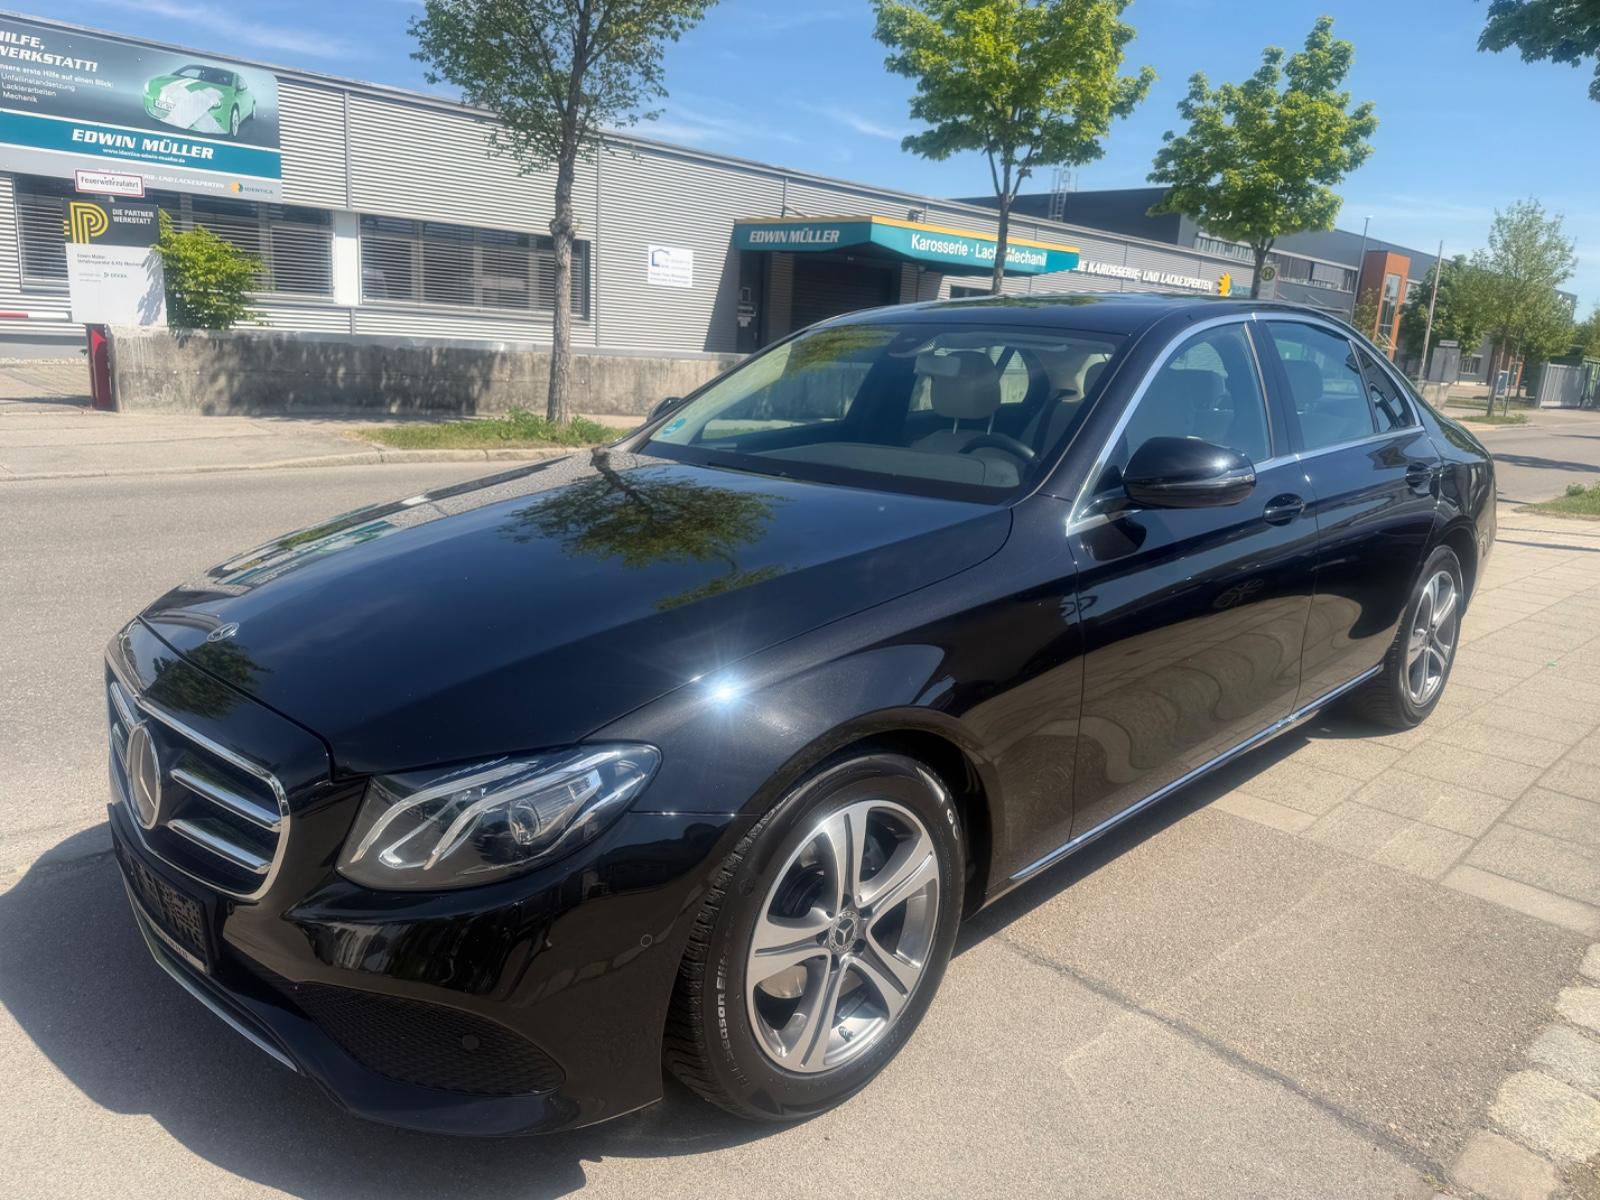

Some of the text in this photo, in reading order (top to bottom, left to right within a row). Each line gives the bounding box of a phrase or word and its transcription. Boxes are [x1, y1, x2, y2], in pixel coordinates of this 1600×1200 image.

[72, 128, 215, 160] EDWIN MÜLLER
[112, 208, 154, 218] DIE PARTNER
[113, 215, 152, 225] WERKSTATT
[749, 228, 840, 243] EDWIN MÜLLER
[911, 233, 969, 256] Karosserie
[1142, 270, 1160, 282] UND
[1160, 273, 1213, 291] LACKEXPERTEN
